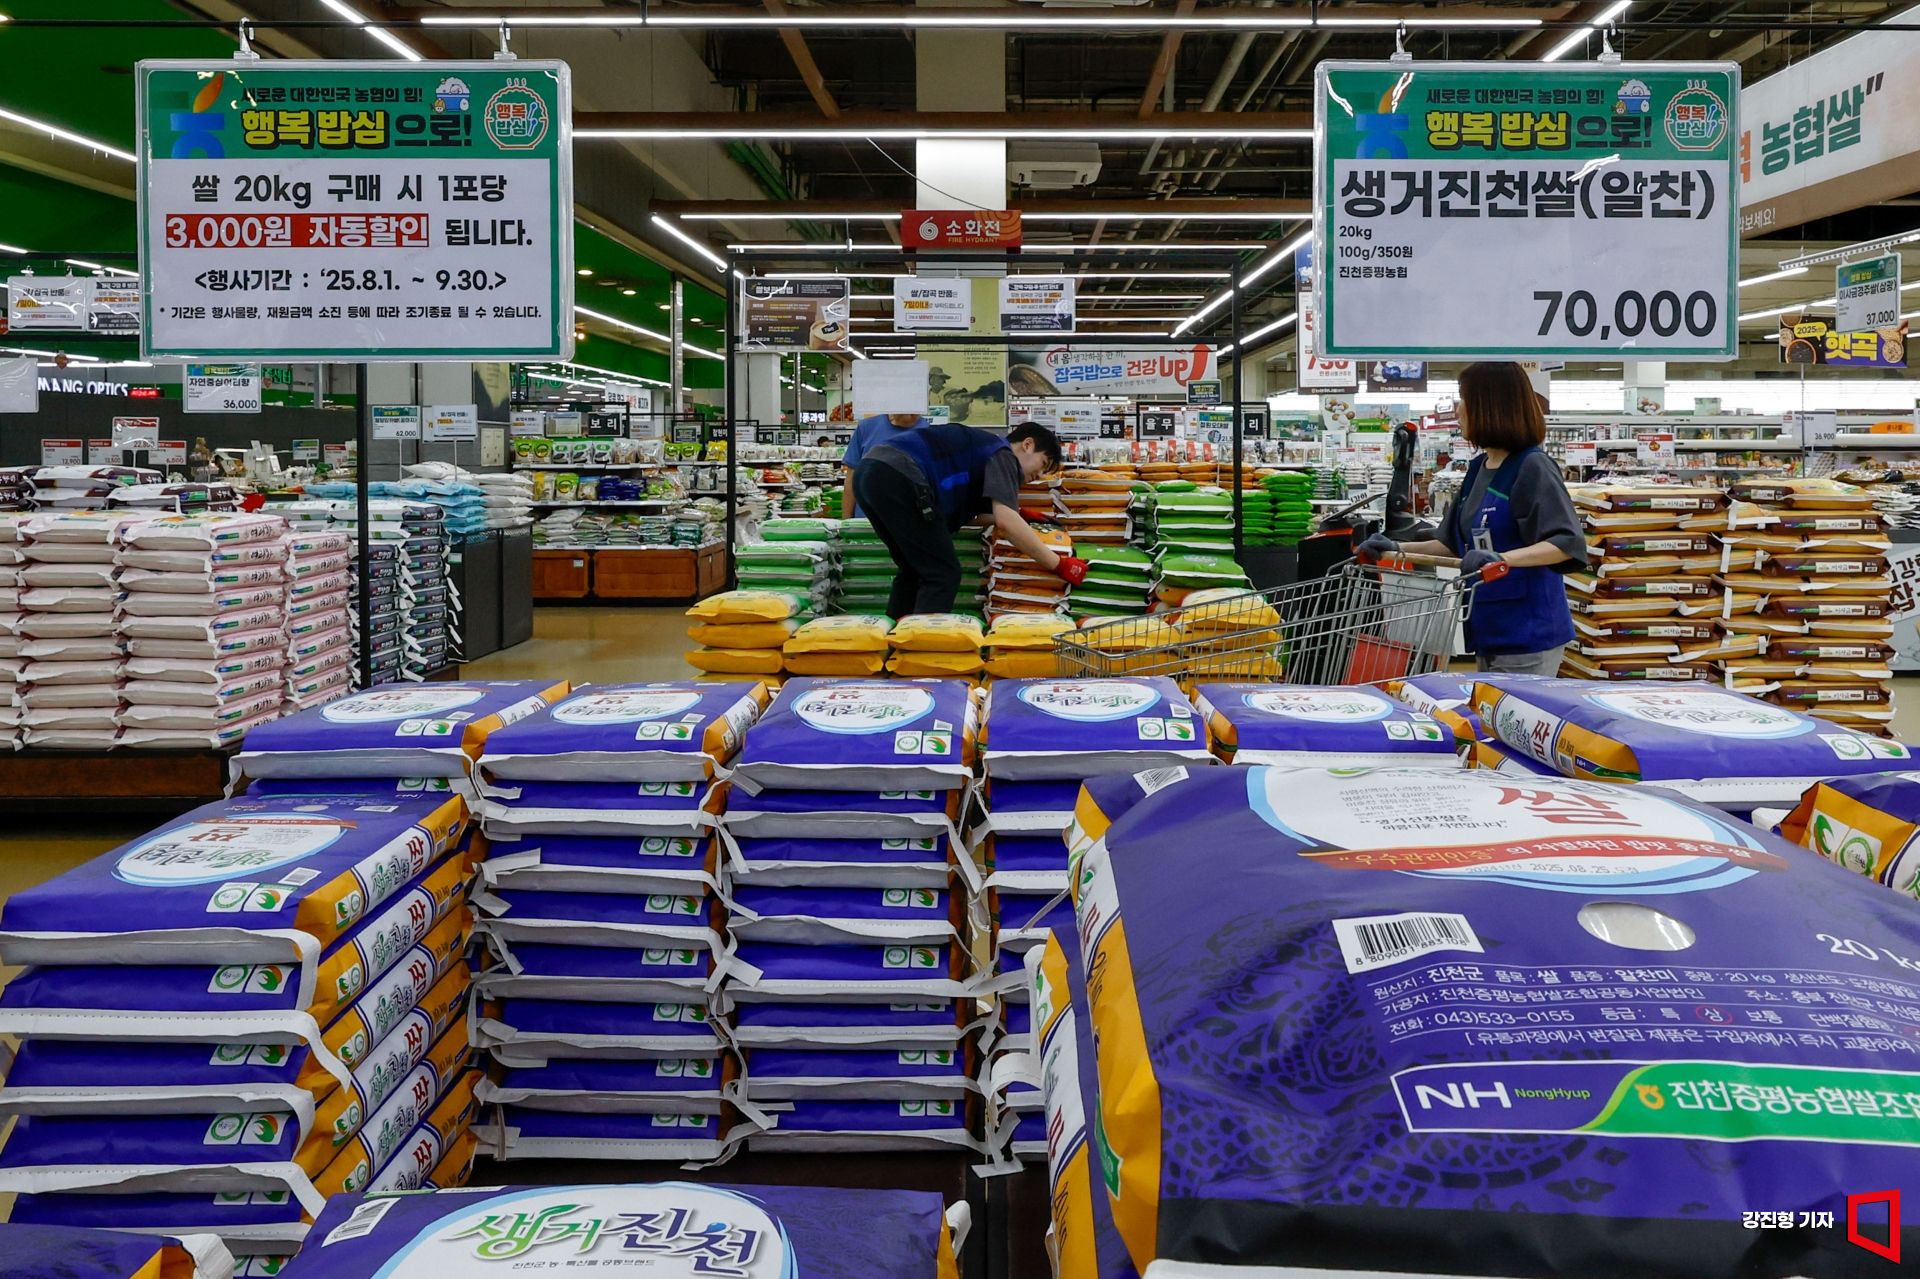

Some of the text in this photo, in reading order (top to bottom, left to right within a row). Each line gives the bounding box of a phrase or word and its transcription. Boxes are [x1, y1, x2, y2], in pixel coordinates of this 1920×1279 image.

[242, 87, 423, 102] 새로운 대한민국 농협의 힘!
[1426, 88, 1605, 104] 새로운 대한민국 농협의 힘!
[496, 104, 526, 120] 행복
[1676, 104, 1706, 121] 행복
[242, 110, 472, 147] 행복 밥심 으로!
[496, 120, 527, 137] 밥심
[1426, 111, 1651, 148] 행복 밥심 으로!
[1676, 121, 1707, 138] 밥심
[192, 175, 507, 208] 쌀 20kg 구매 시 1포당
[1341, 169, 1715, 219] 생거진천쌀(알찬)
[167, 215, 533, 247] 3,000원 자동할인 됩니다.
[946, 219, 1000, 237] 소화전
[1339, 225, 1372, 240] 20kg
[1339, 245, 1413, 259] 100g/350원
[194, 270, 292, 291] <행사기간
[303, 273, 309, 289] :
[412, 275, 425, 285] ~
[436, 270, 507, 291] 9.30.>
[1339, 266, 1408, 279] 진천증평농협
[911, 290, 937, 298] 쌀/잡곡
[171, 306, 206, 319] 기간은
[212, 306, 261, 320] 행사물량,
[267, 306, 312, 319] 재원금액
[318, 306, 341, 319] 소진
[348, 306, 370, 319] 등에
[376, 306, 400, 319] 따라
[406, 306, 451, 319] 조기종료
[457, 306, 469, 319] 될
[475, 306, 485, 319] 수
[492, 306, 542, 319] 있습니다.
[1533, 290, 1717, 340] 70,000
[1866, 310, 1894, 326] 37,000
[1825, 330, 1878, 361] 햇곡
[1055, 364, 1122, 383] 잡곡밥으로
[1127, 359, 1157, 377] 건강
[223, 400, 258, 409] 36,000
[1490, 786, 1642, 827] 쌀
[1816, 933, 1879, 961] 20
[1427, 966, 1484, 983] 진천군
[1537, 970, 1561, 984] 쌀
[1614, 968, 1679, 983] 알찬미
[1390, 1018, 1423, 1036] 전화
[1435, 1010, 1575, 1025] 043)533-0155
[1704, 1009, 1724, 1024] 상
[1649, 1028, 1704, 1043] 제품은
[1414, 1081, 1513, 1110] NH
[1515, 1086, 1591, 1101] NongHyup
[454, 1204, 762, 1278] 생거진천
